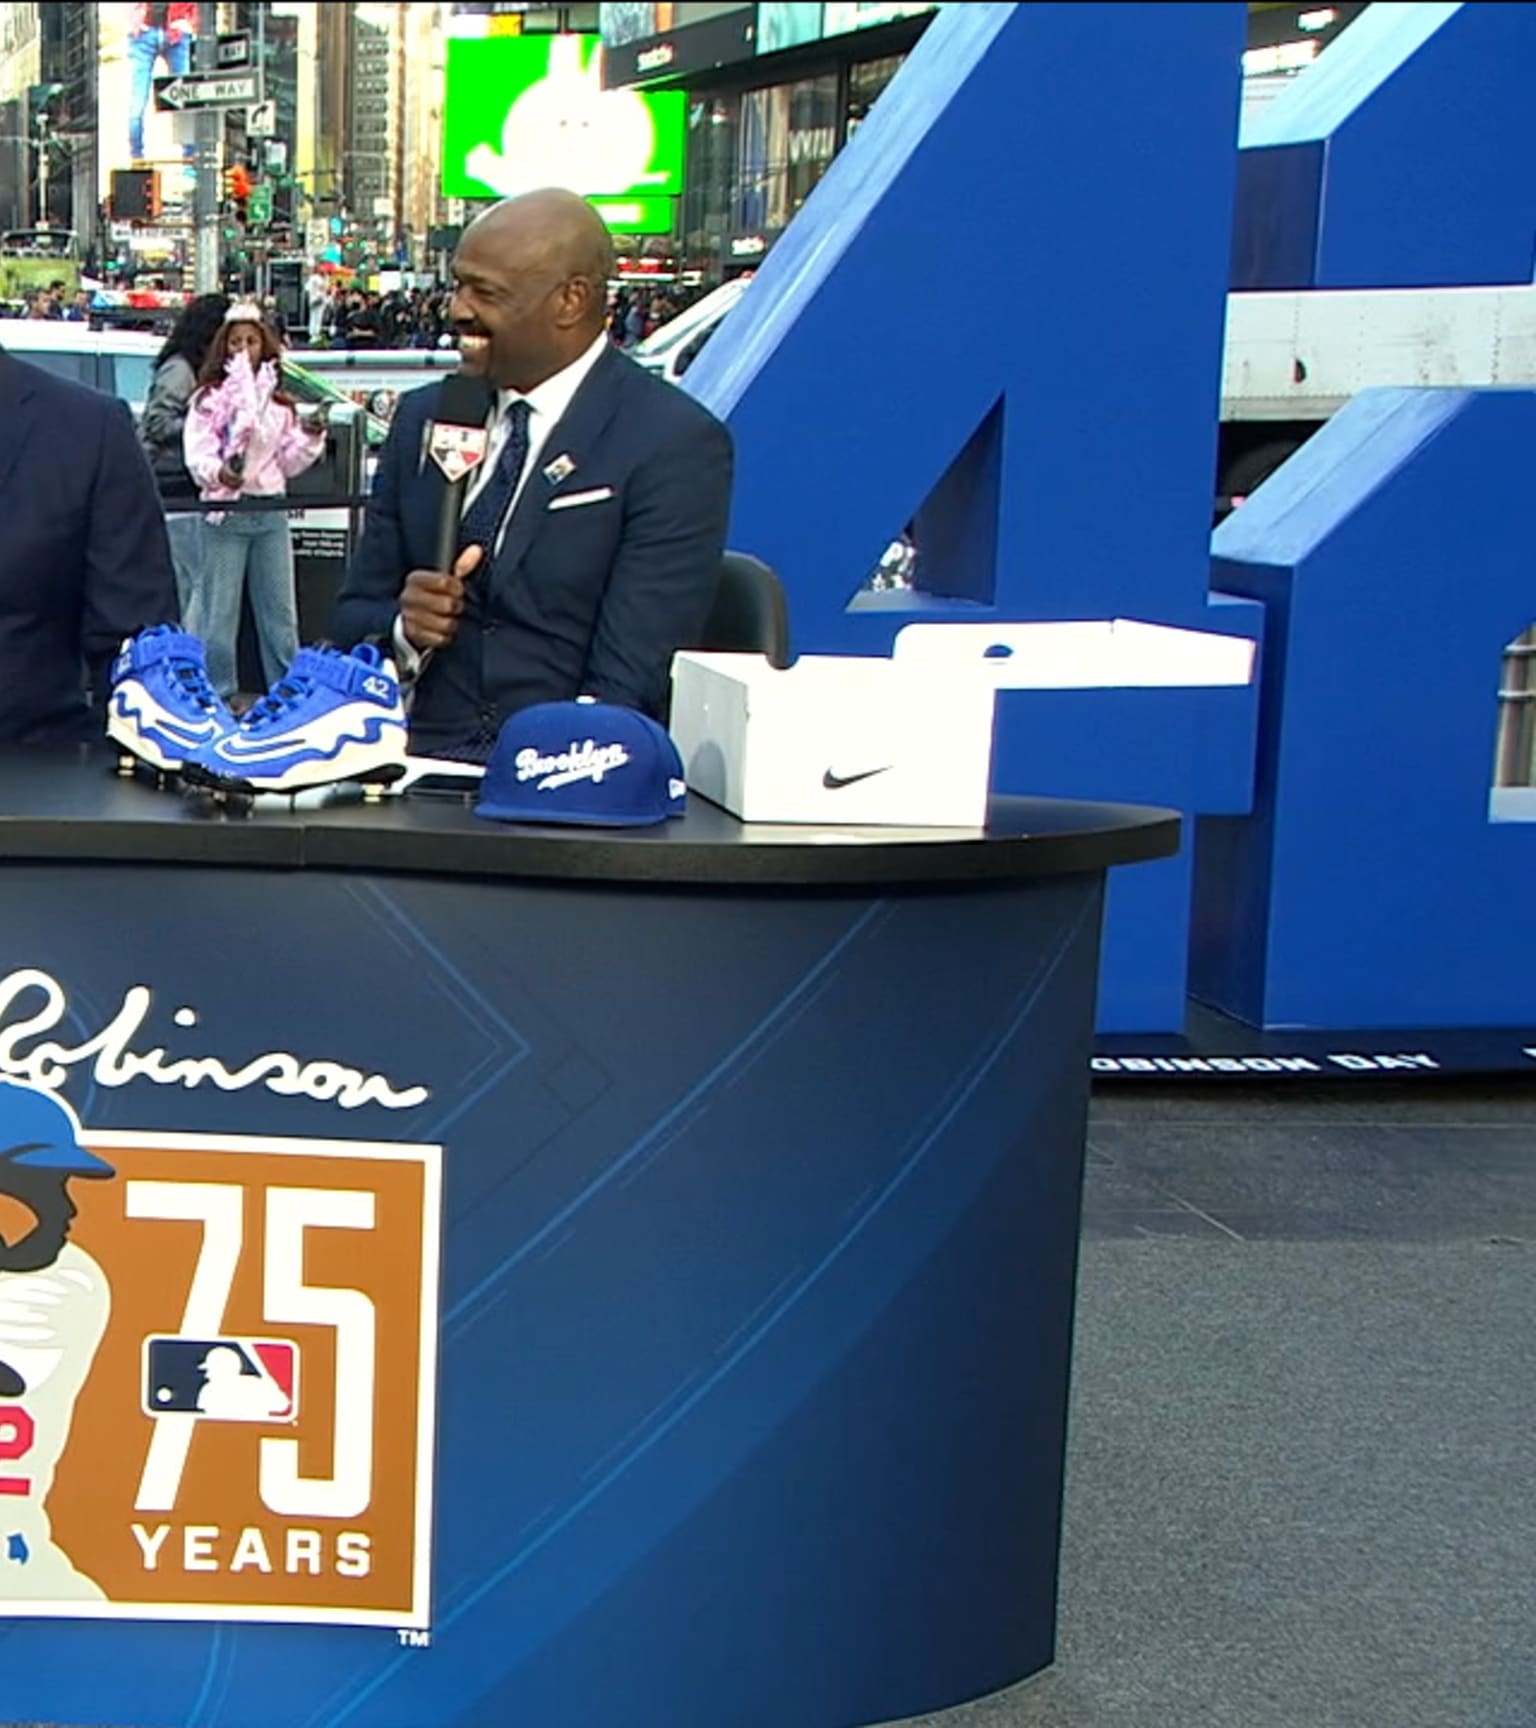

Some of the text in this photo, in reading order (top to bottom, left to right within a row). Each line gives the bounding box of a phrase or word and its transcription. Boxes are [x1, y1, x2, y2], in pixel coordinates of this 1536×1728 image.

[169, 82, 247, 101] ONE WAY
[362, 676, 389, 699] 42
[515, 739, 630, 790] Brooklyn
[1090, 1053, 1443, 1071] OBINSON DAY
[125, 1180, 377, 1517] 75
[132, 1523, 374, 1578] YEARS
